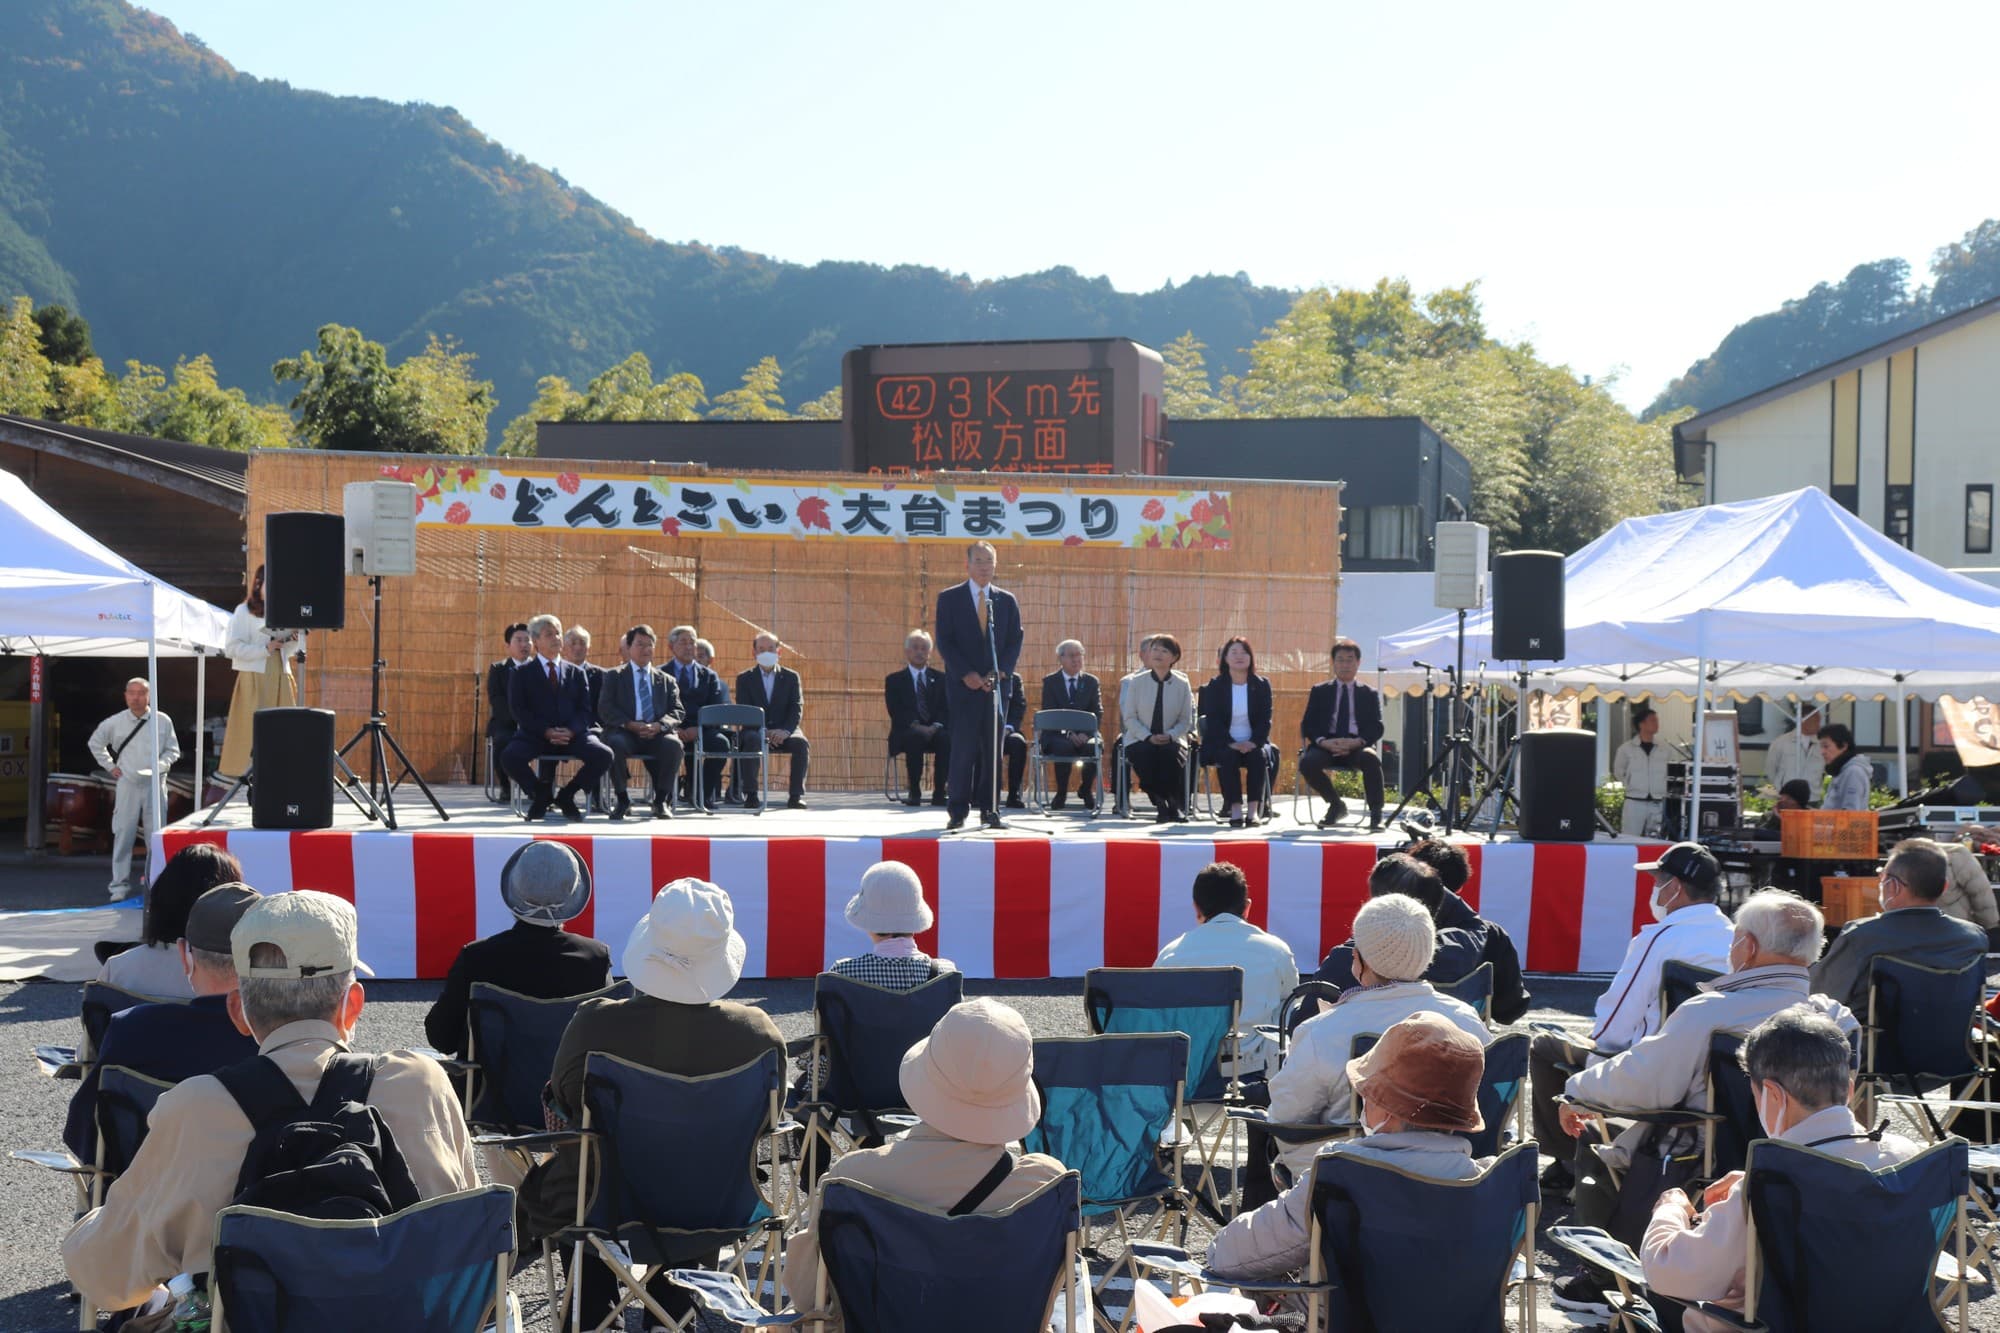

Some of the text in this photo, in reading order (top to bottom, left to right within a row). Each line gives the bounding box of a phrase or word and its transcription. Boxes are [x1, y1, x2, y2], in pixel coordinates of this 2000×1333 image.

[891, 384, 922, 412] 42
[911, 418, 1068, 462] 松阪方面
[512, 477, 1119, 540] どんとこい 大台まつり
